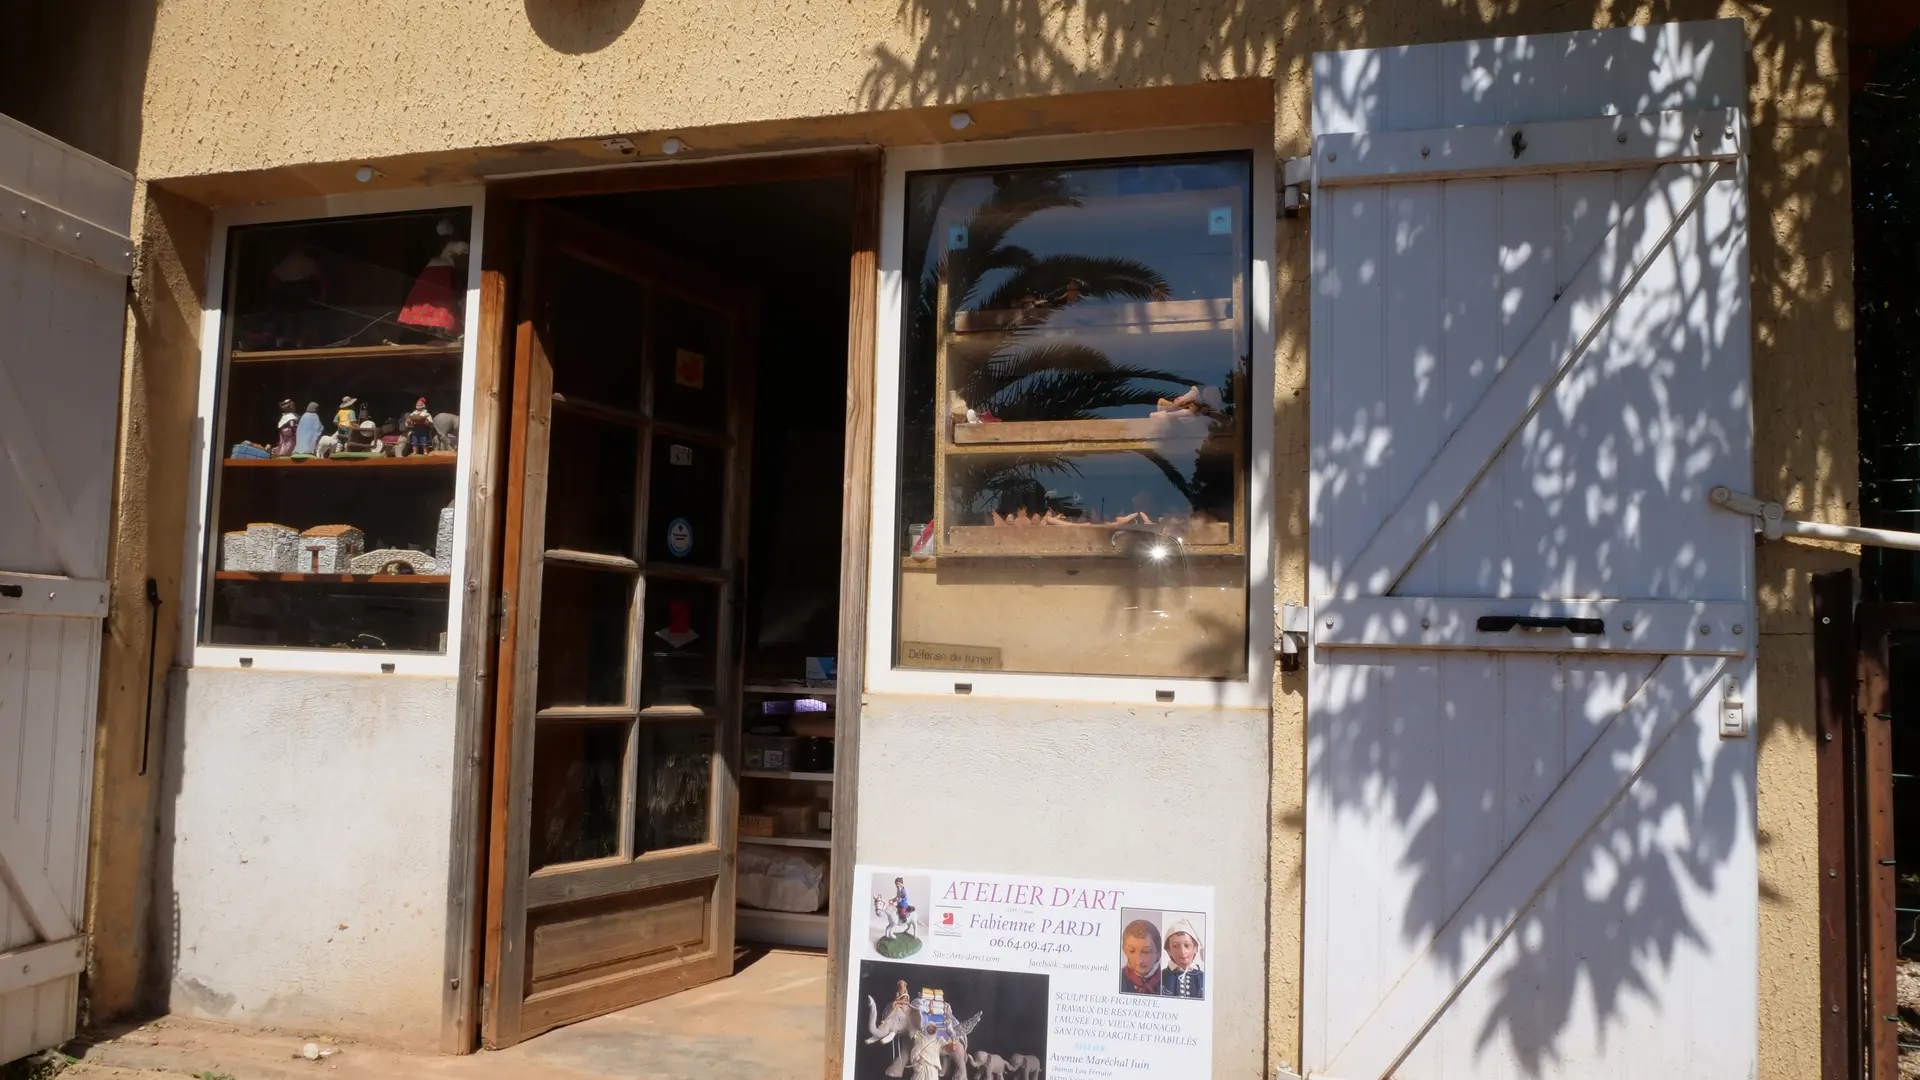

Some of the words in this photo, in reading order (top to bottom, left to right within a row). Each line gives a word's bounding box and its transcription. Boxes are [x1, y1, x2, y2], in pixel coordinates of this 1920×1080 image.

[908, 648, 946, 661] Défense
[950, 652, 962, 662] de
[965, 653, 993, 664] fumer
[943, 880, 1044, 906] ATELIER
[1050, 886, 1125, 911] D'ART
[968, 912, 1036, 933] Fabienne
[1041, 918, 1102, 938] PARDI
[989, 936, 1073, 955] 06.64.09.47.40.
[1028, 957, 1057, 968] facebook
[1063, 962, 1090, 970] santons
[1091, 963, 1110, 973] pardi
[1055, 1003, 1094, 1015] TRAVAUX
[1096, 1006, 1109, 1015] DE
[1110, 1007, 1179, 1021] RESTAURATION
[1092, 1018, 1105, 1027] DU
[1108, 1019, 1136, 1030] VIEUX
[1138, 1022, 1181, 1033] MONACO)
[1053, 1026, 1096, 1038] SANTONS
[1098, 1029, 1139, 1041] D'ARGILE
[1140, 1033, 1152, 1042] ET
[1154, 1034, 1197, 1046] HABILLÉS
[1050, 1052, 1083, 1064] Avenue
[1085, 1054, 1128, 1068] Maréchal
[1130, 1058, 1150, 1070] Juin
